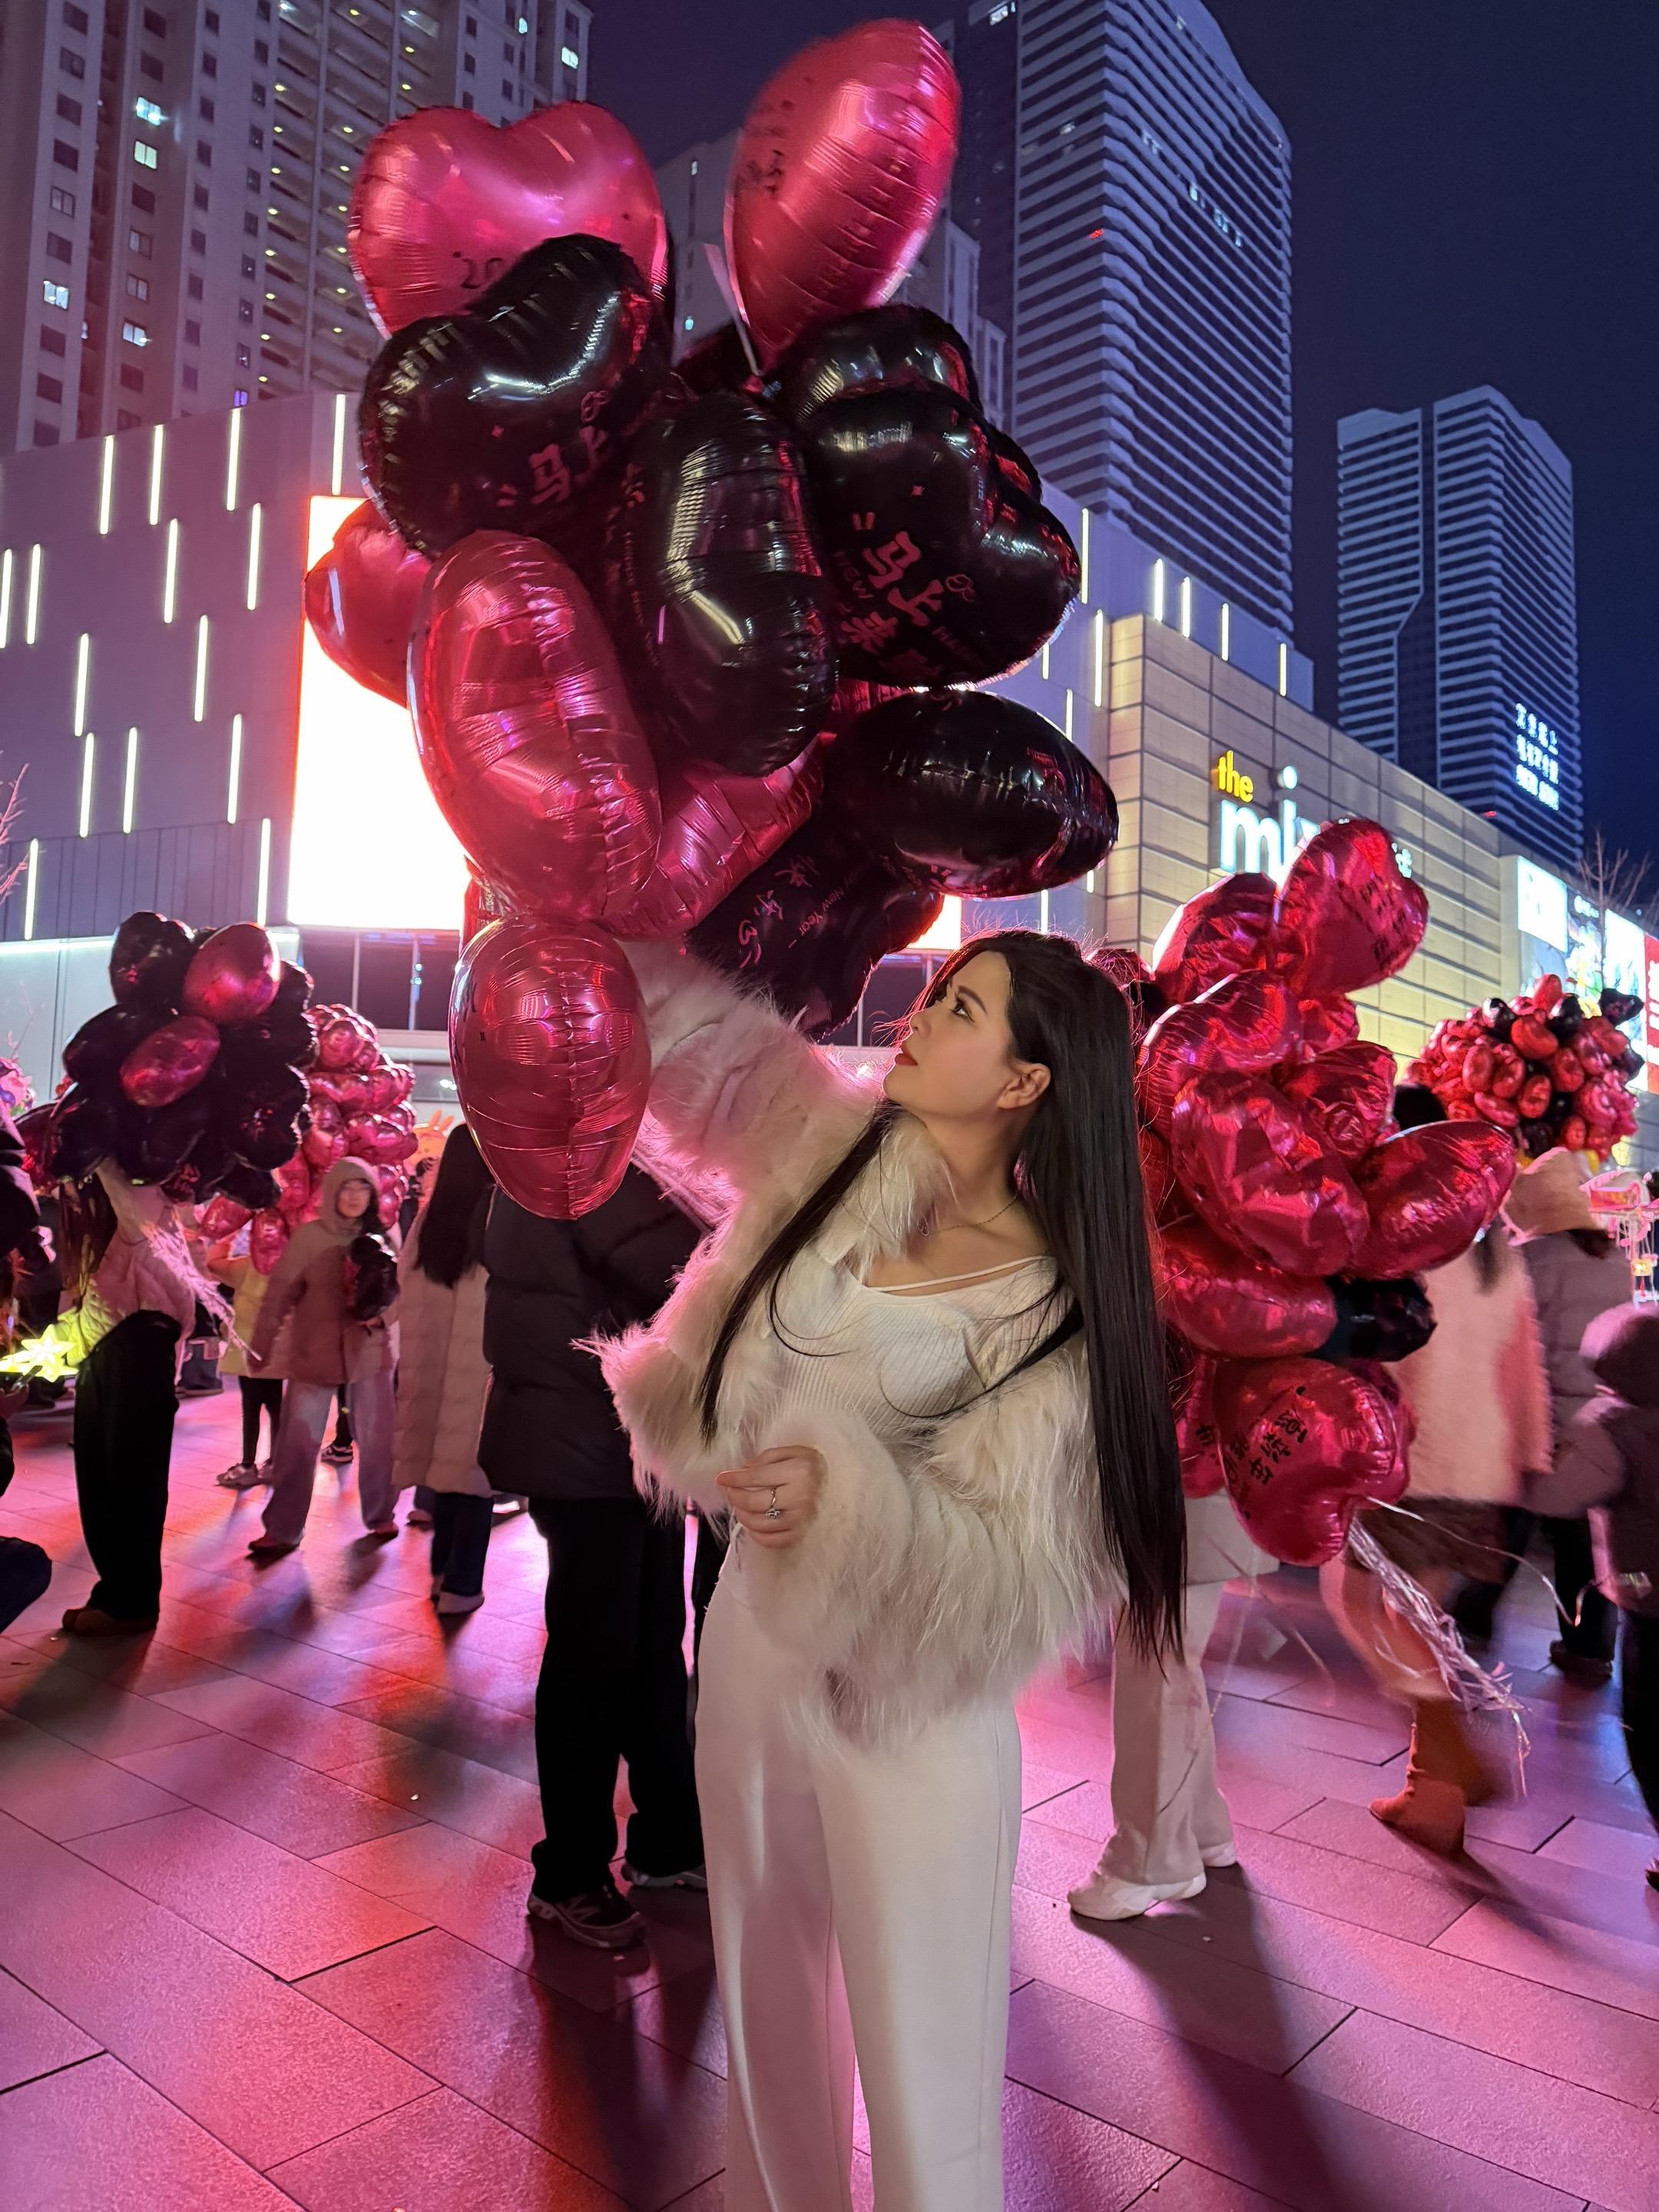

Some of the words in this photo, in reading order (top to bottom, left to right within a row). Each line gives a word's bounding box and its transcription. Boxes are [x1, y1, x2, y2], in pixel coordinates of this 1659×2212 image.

[861, 531, 945, 627] 马上
[1217, 750, 1253, 803] the
[799, 911, 824, 936] Year
